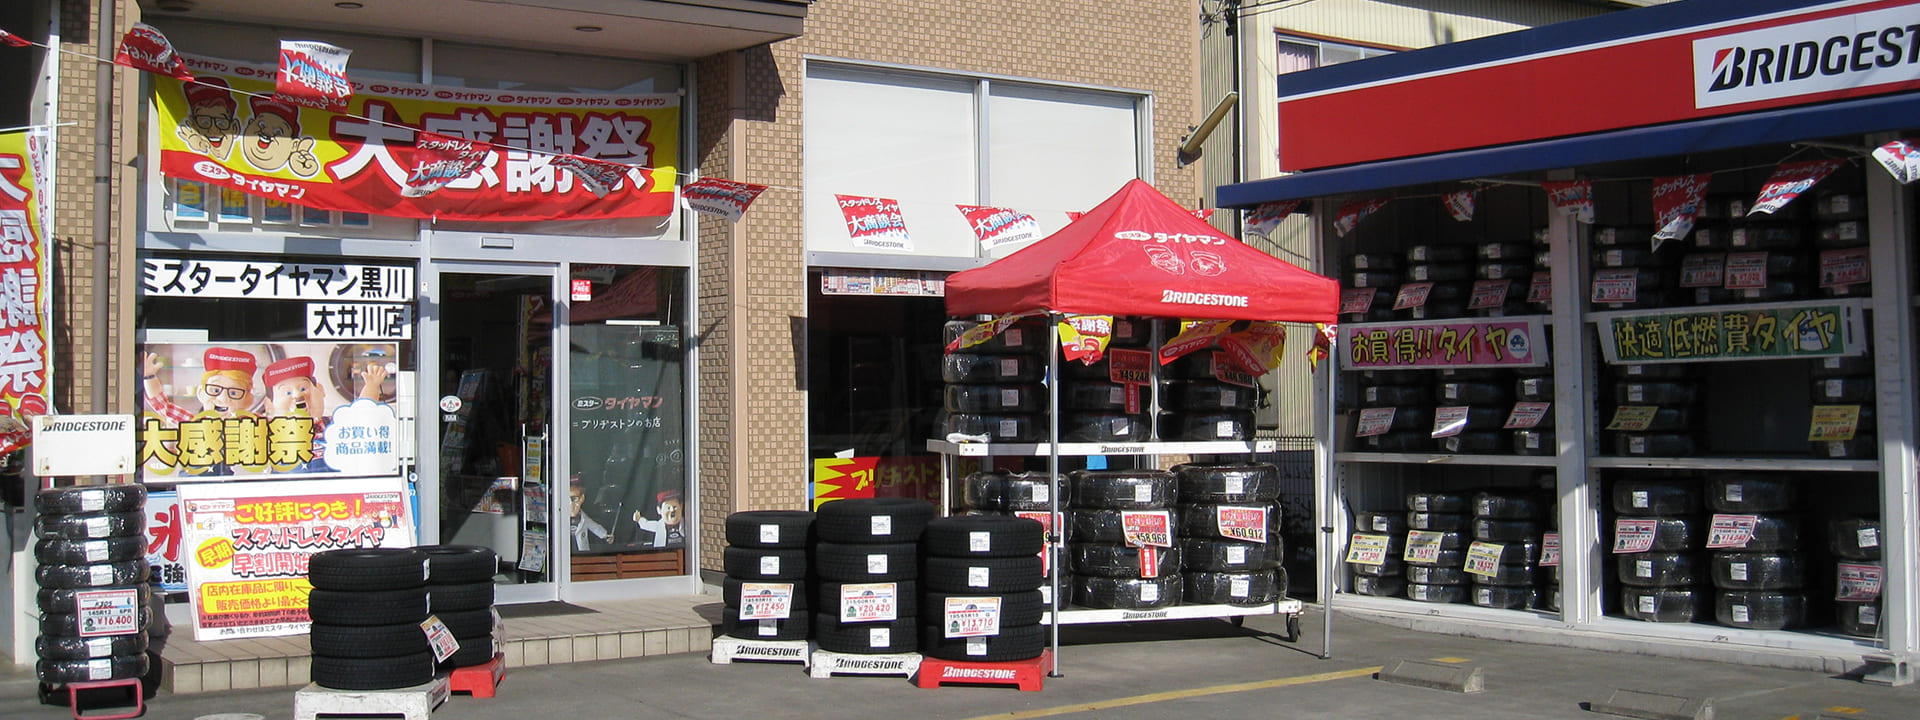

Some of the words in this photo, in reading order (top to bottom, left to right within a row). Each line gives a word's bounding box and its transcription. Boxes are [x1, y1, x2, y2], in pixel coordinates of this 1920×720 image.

[200, 163, 228, 179] ミスター
[232, 172, 306, 200] タイヤマン
[848, 214, 904, 236] 大商談会
[1153, 231, 1226, 245] タイヤマン
[144, 262, 406, 299] ミスタータイヤマン黒川
[1161, 289, 1248, 308] BRIDGESTONE
[313, 305, 405, 337] 大井川店
[1614, 309, 1837, 358] 快適低燃費タイヤ
[604, 396, 664, 411] タイヤマン
[42, 419, 127, 433] BRIDGESTONE
[337, 425, 390, 440] お買い得
[143, 417, 315, 468] 大感謝祭
[148, 502, 184, 563] 氷
[232, 524, 386, 551] スタッドレスタイヤ
[200, 539, 235, 567] 早期
[232, 551, 310, 578] 早割開始
[735, 644, 802, 657] BRIDGESTONE
[835, 657, 905, 670] BRIDGESTONE
[941, 665, 1018, 680] BRIDGESTONE
